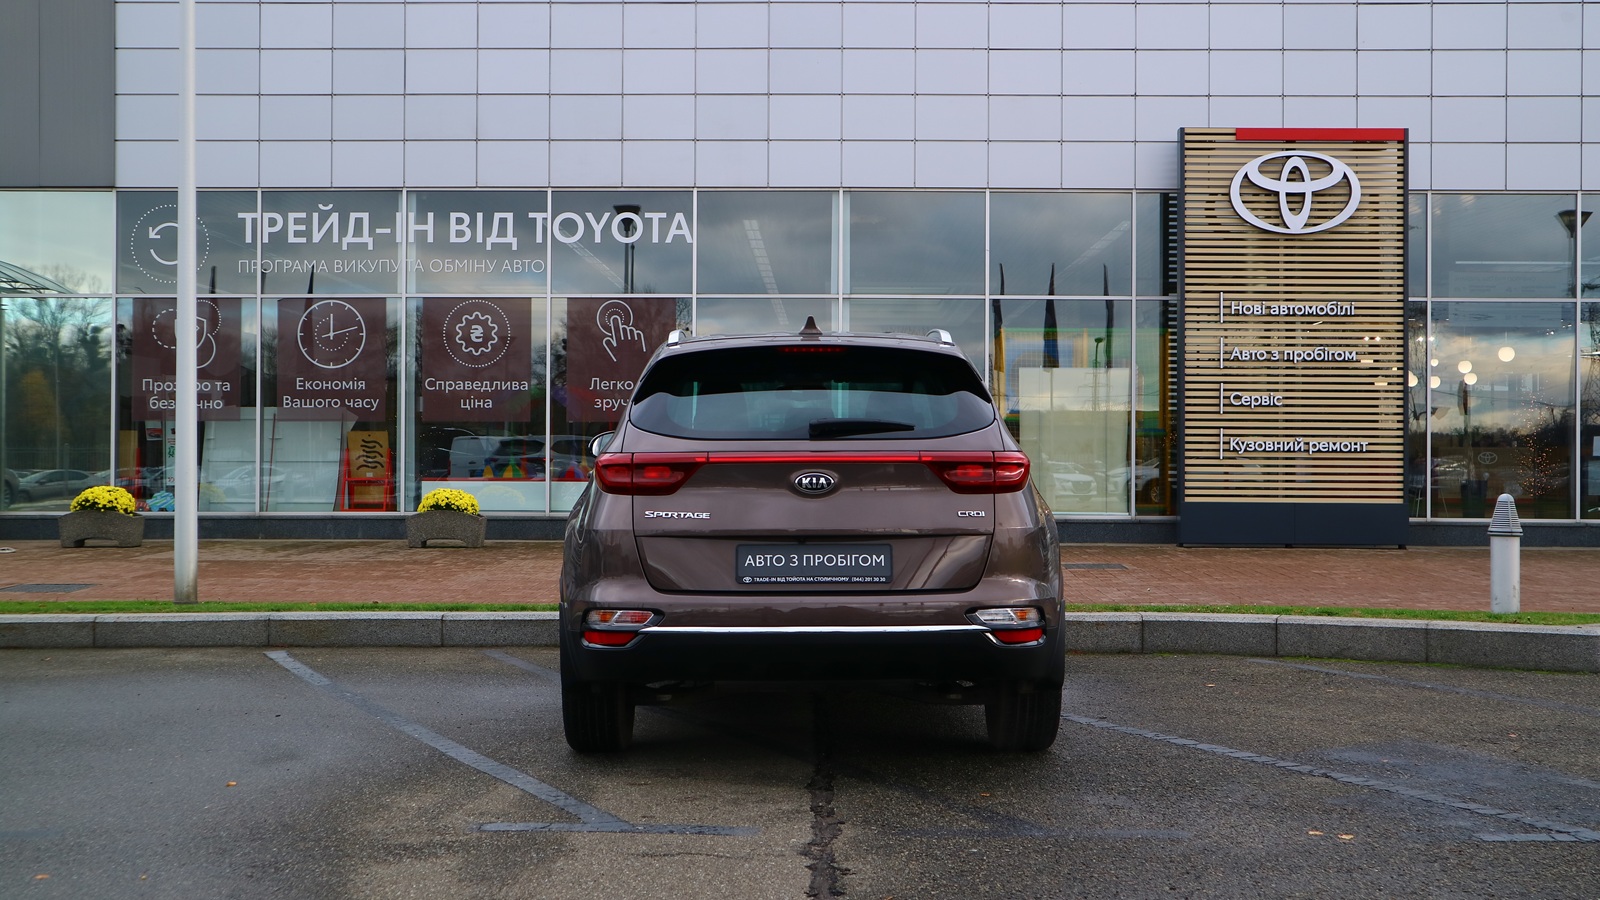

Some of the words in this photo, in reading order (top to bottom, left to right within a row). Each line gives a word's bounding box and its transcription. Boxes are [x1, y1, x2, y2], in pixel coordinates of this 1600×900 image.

[237, 203, 434, 250] ТРЕЙД-ІН
[450, 212, 518, 250] ВІД
[528, 211, 693, 243] TOYOTA
[238, 259, 329, 273] ПРОГРАМА
[334, 259, 400, 273] ВИКУПУ
[406, 259, 424, 273] ТА
[429, 259, 497, 273] ОБМІНУ
[501, 259, 545, 273] АВТО
[1231, 301, 1266, 315] Нові
[1270, 301, 1355, 315] автомобілі
[1230, 346, 1267, 360] Авто
[1270, 349, 1279, 360] з
[1284, 346, 1357, 364] пробігом
[142, 378, 211, 394] Проо
[214, 381, 231, 391] та
[296, 377, 366, 390] Економія
[424, 377, 529, 393] Справедлива
[589, 377, 634, 390] Легко
[149, 396, 223, 409] безчно
[283, 395, 341, 408] Вашого
[345, 398, 380, 411] часу
[460, 395, 493, 410] ціна
[1230, 391, 1283, 409] Сервіс
[1229, 437, 1305, 454] Кузовний
[1308, 441, 1369, 455] ремонт
[801, 477, 828, 489] KIA
[644, 510, 711, 519] SPORTAGE
[744, 554, 786, 567] АВТО
[789, 554, 799, 567] З
[803, 554, 885, 567] ПРОБІГОМ
